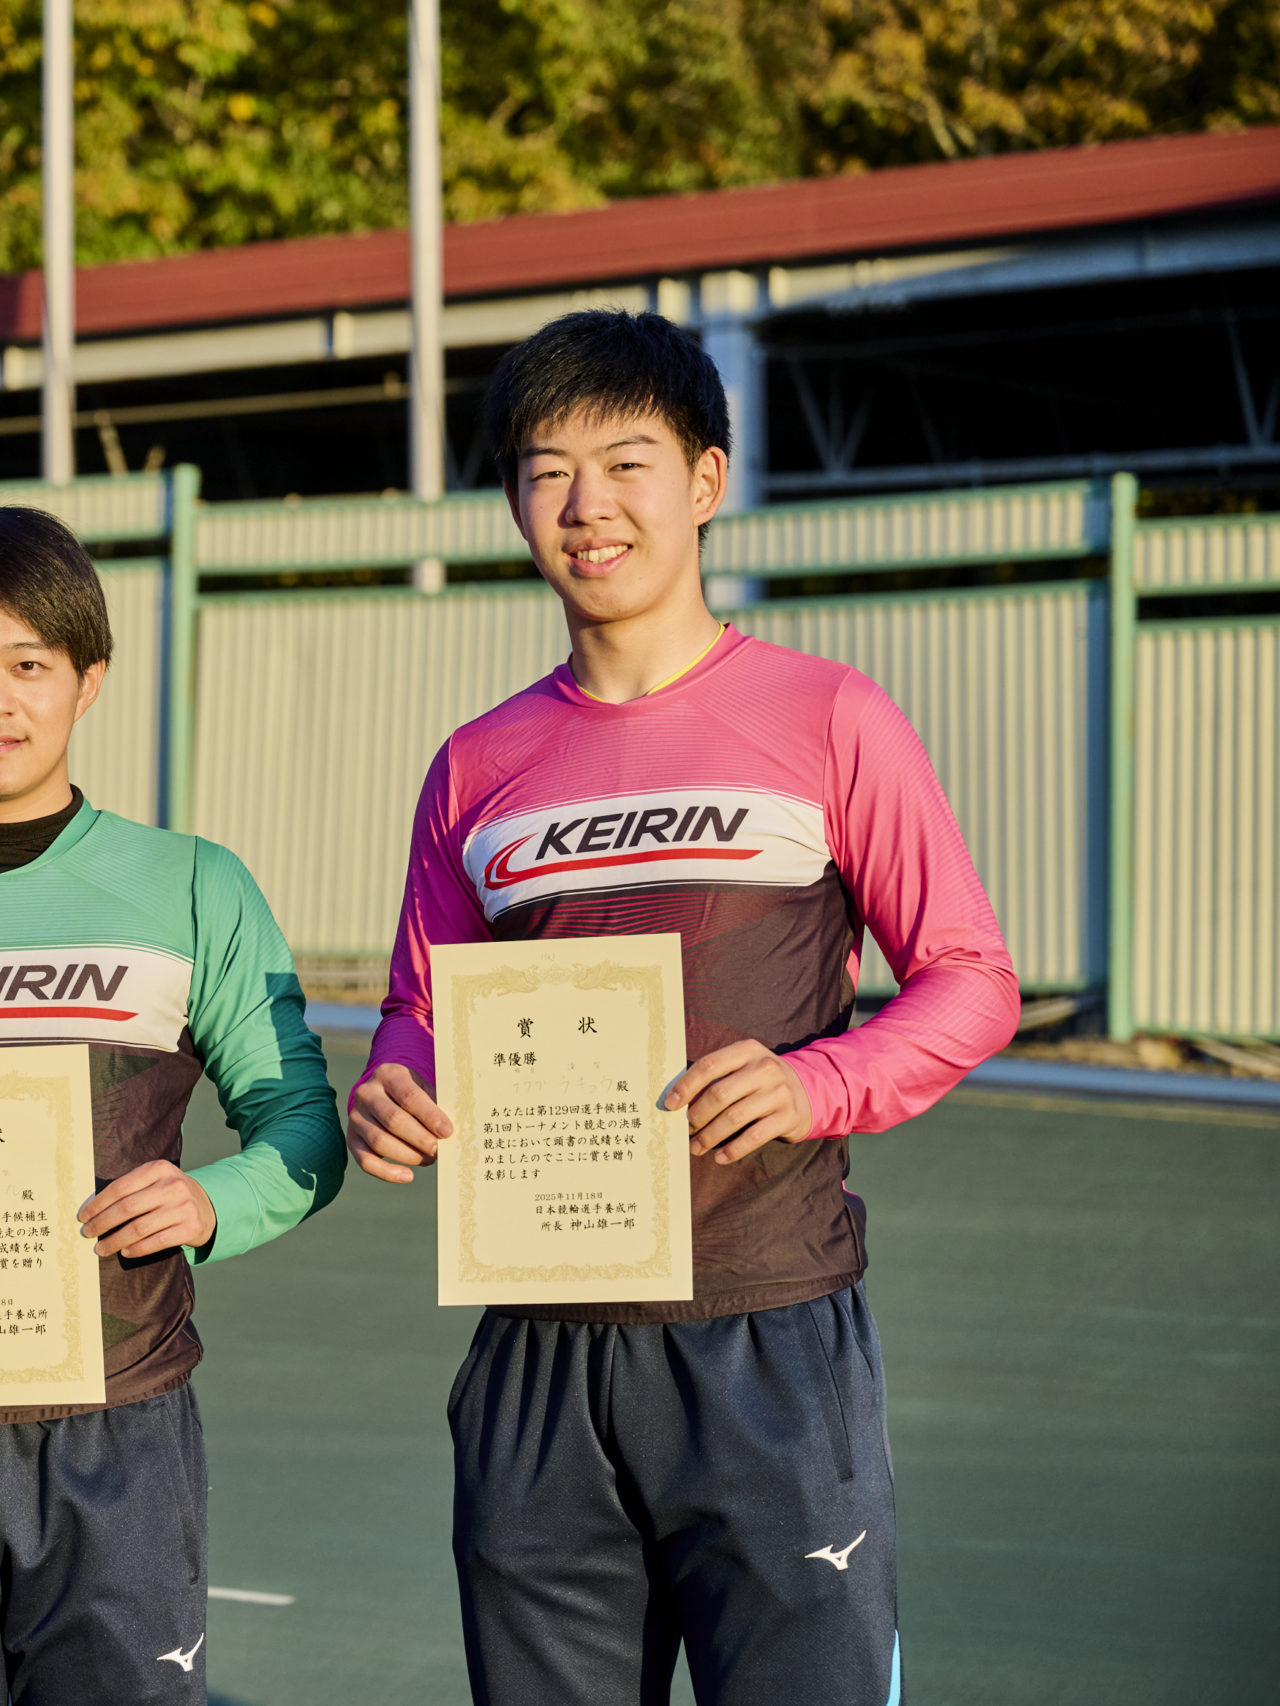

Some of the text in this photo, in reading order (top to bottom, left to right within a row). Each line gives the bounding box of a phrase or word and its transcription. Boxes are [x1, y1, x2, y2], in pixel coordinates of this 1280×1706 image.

[535, 806, 749, 861] KEIRIN
[493, 1051, 537, 1068] 準優勝
[541, 1220, 563, 1232] 所長
